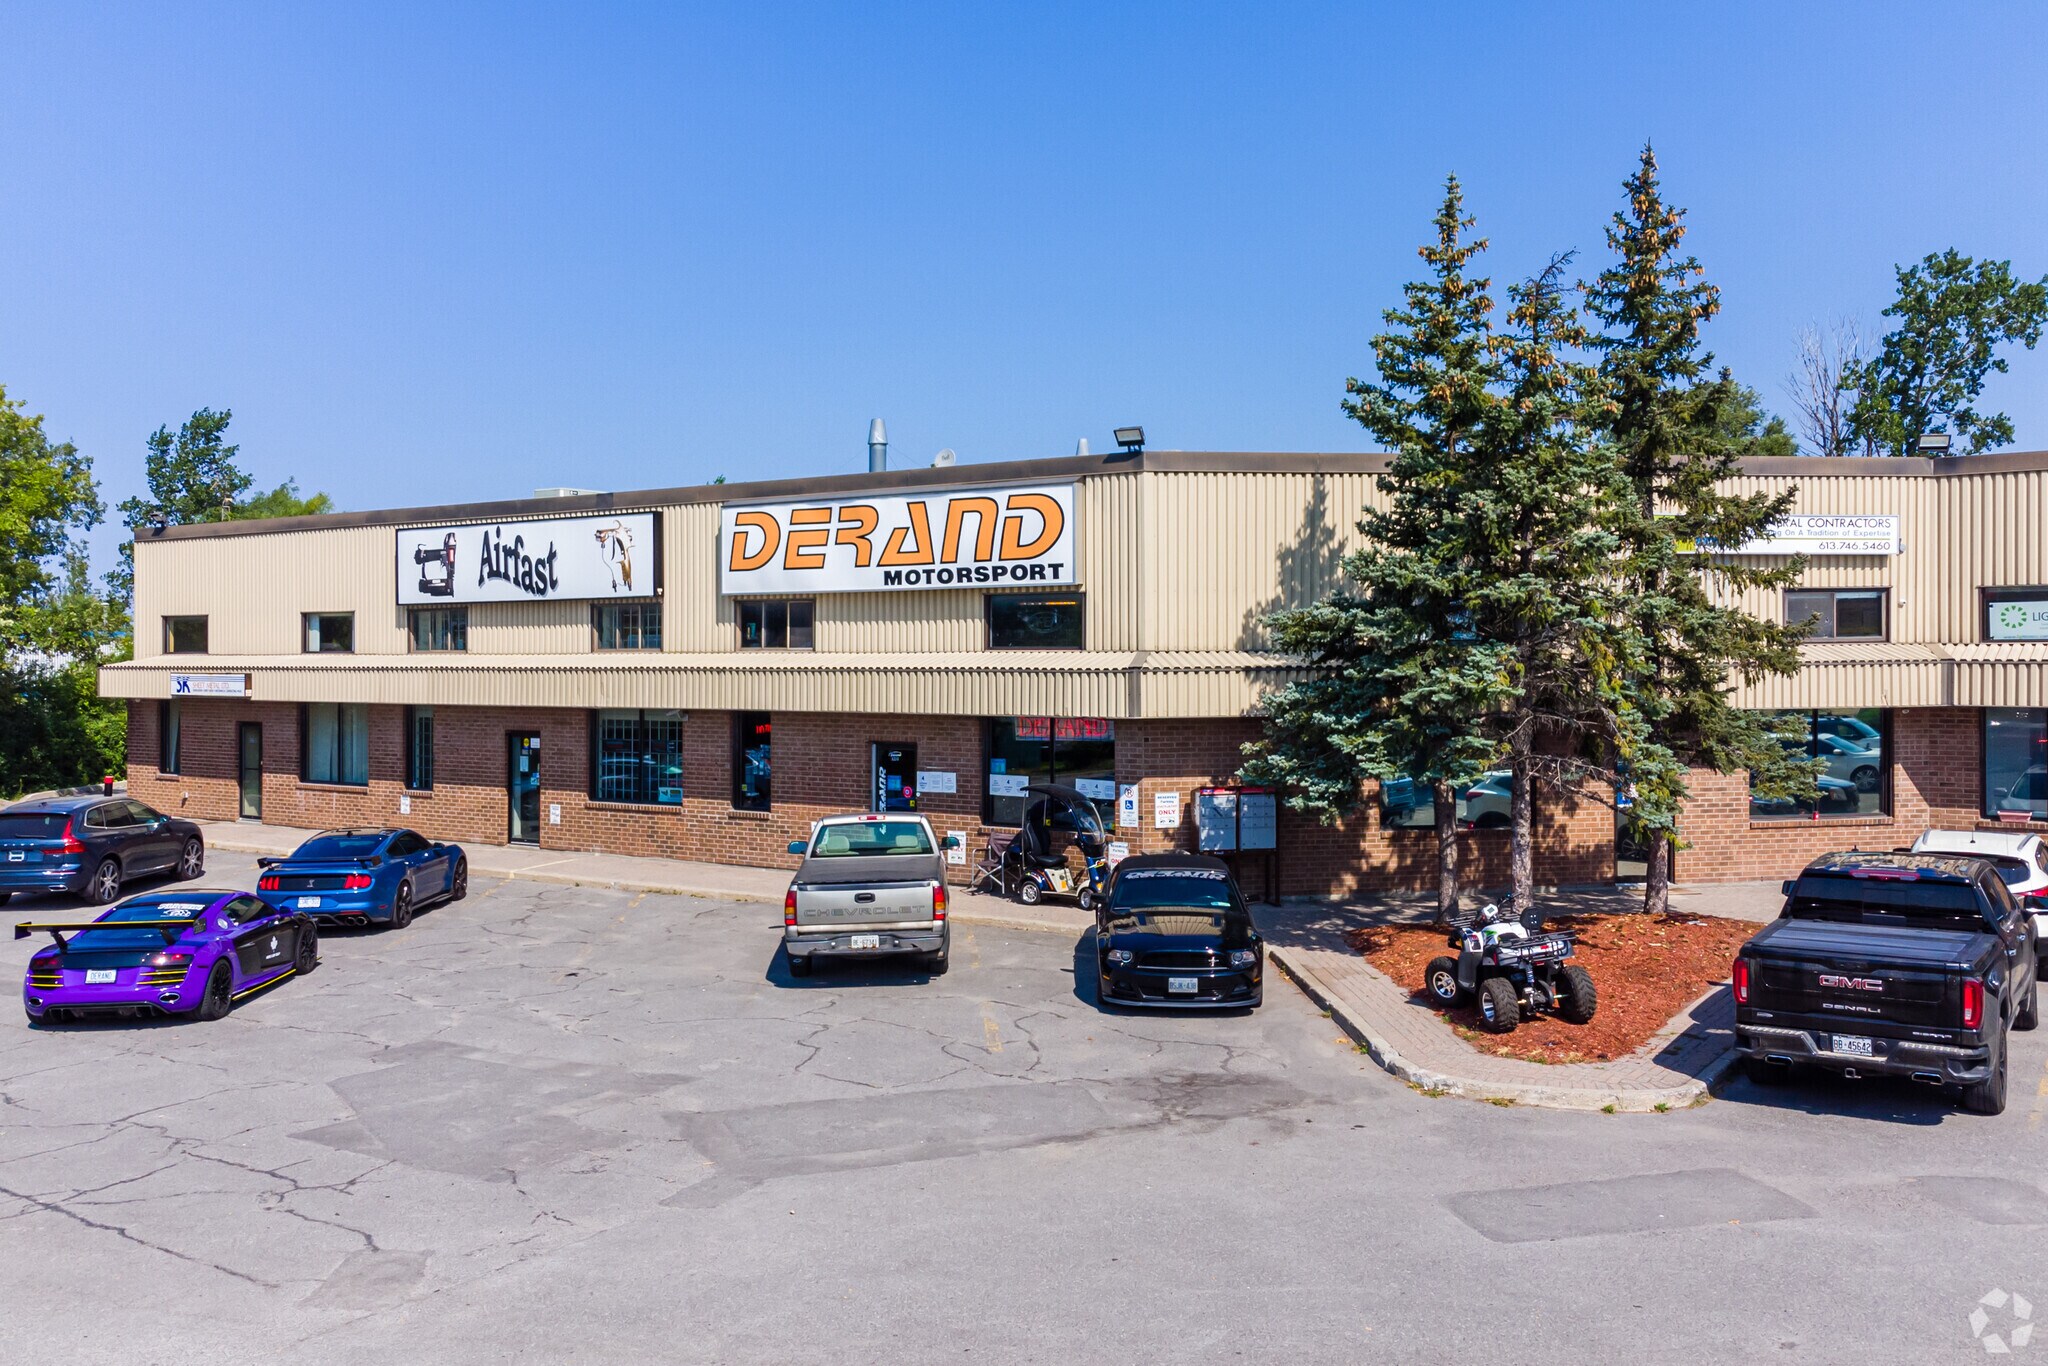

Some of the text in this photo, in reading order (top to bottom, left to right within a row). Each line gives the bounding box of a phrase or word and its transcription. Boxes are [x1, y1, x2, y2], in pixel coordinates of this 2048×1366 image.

[1808, 518, 1891, 528] CONTRACTORS
[729, 493, 1065, 572] DERAND
[1807, 529, 1839, 537] Tradition
[1853, 529, 1891, 538] Expertise
[1819, 541, 1891, 550] 613.746.5460
[478, 526, 559, 597] Airfast
[883, 563, 1064, 586] MOTORSPORT
[176, 676, 191, 693] SK
[804, 905, 925, 917] CHEVROLET
[1819, 975, 1883, 991] GMC
[1823, 1003, 1881, 1013] DENALI
